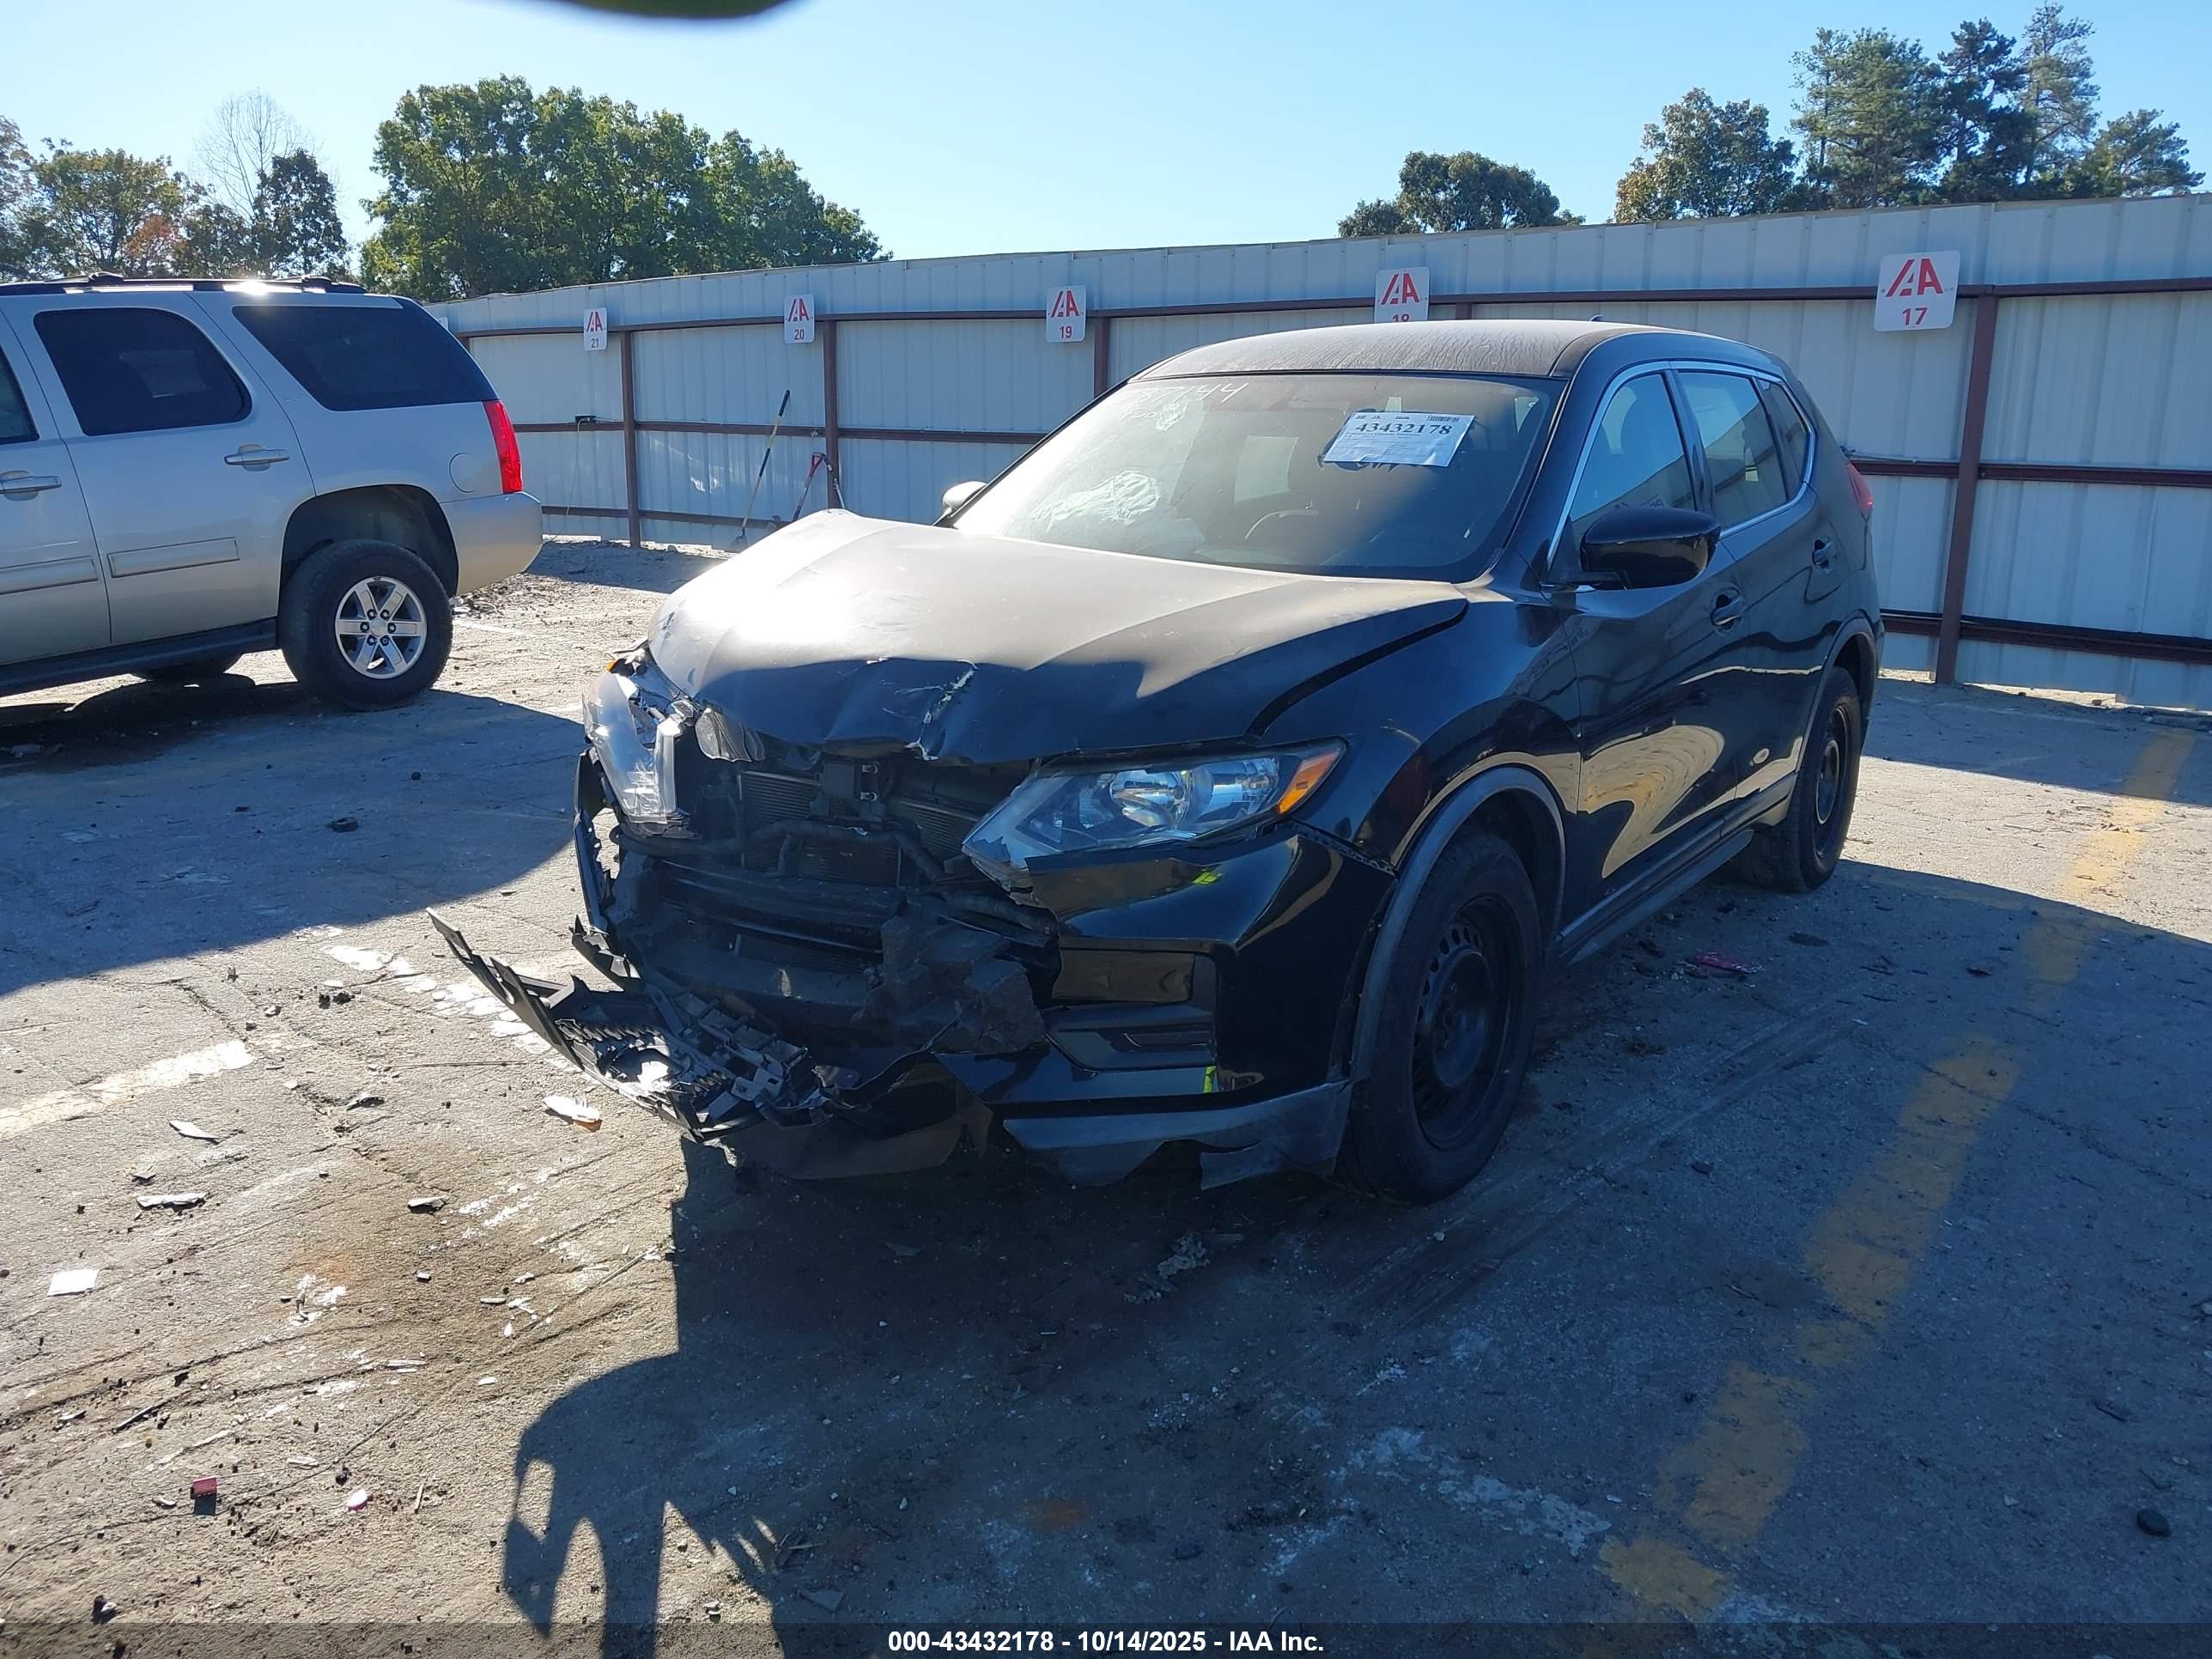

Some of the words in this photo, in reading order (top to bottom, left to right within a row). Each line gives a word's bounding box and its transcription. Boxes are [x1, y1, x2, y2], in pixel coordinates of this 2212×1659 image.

[1902, 307, 1928, 326] 17
[794, 329, 805, 340] 20
[1059, 325, 1072, 339] 19
[591, 337, 599, 348] 21
[1355, 422, 1453, 435] 43432178
